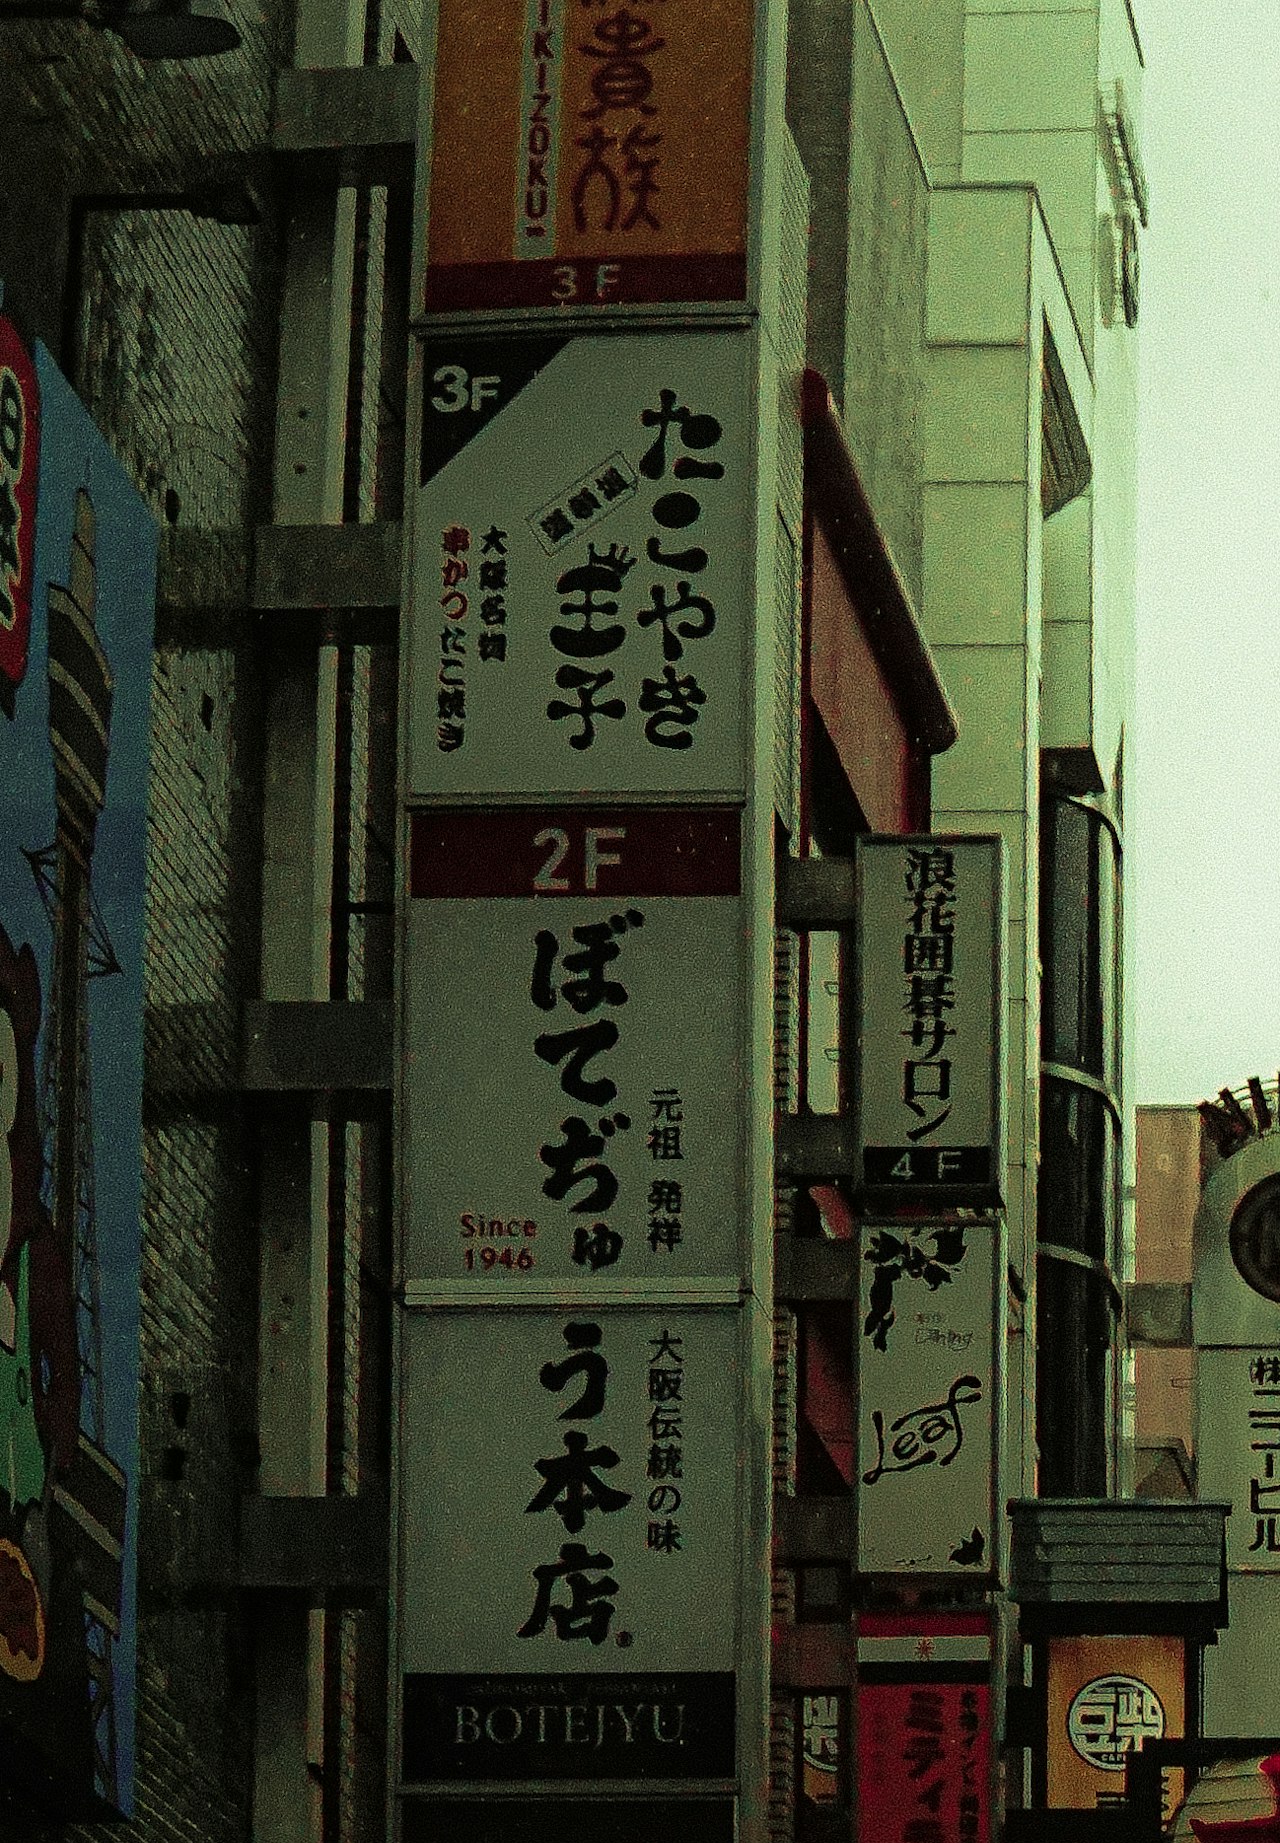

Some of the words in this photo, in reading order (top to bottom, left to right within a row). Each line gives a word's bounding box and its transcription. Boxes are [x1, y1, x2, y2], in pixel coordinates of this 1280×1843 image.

[572, 0, 664, 232] 貴族
[431, 365, 502, 413] 3F
[637, 389, 725, 750] たこやき
[547, 564, 627, 750] 王子
[533, 829, 628, 890] 2F
[904, 848, 957, 1142] 浪花囲碁サロン
[648, 1088, 684, 1160] 元祖
[460, 1212, 537, 1241] Since
[463, 1245, 533, 1272] 1946
[647, 1330, 684, 1553] 大阪伝統の味
[864, 1376, 983, 1484] Leaf
